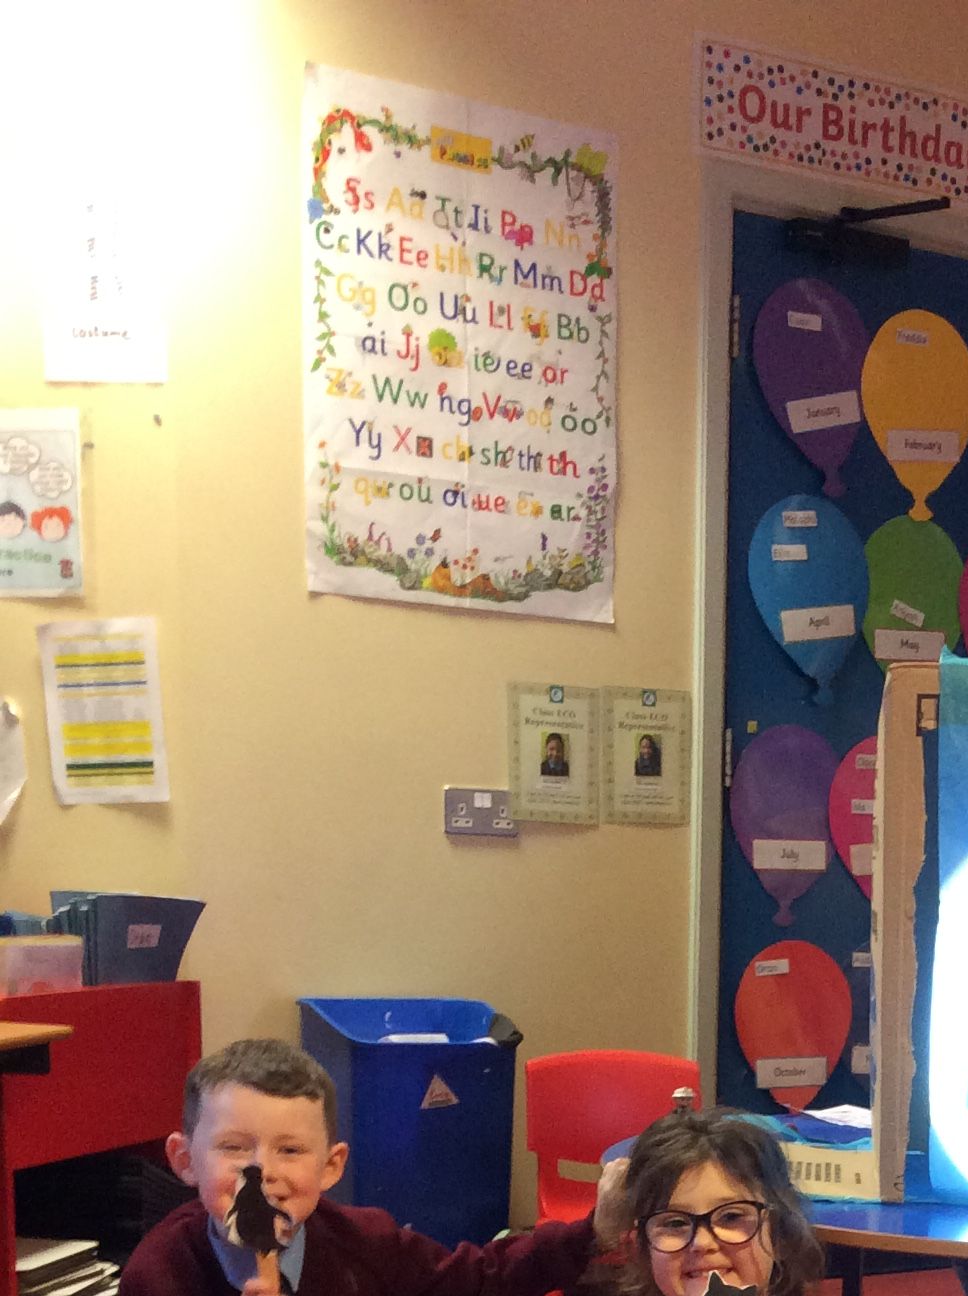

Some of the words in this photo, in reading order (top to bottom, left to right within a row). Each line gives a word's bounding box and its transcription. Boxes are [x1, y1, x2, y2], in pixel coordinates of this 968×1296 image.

[738, 84, 812, 134] Our
[356, 227, 393, 262] Kk
[398, 236, 429, 268] Ee
[513, 258, 564, 294] Mm
[569, 269, 606, 302] Dd
[387, 281, 428, 316] Oo
[439, 291, 480, 325] Uu
[556, 313, 591, 344] Bb
[371, 372, 430, 410] Ww
[505, 358, 534, 380] ee
[541, 363, 570, 386] or
[348, 417, 382, 461] Yy
[900, 638, 921, 654] May
